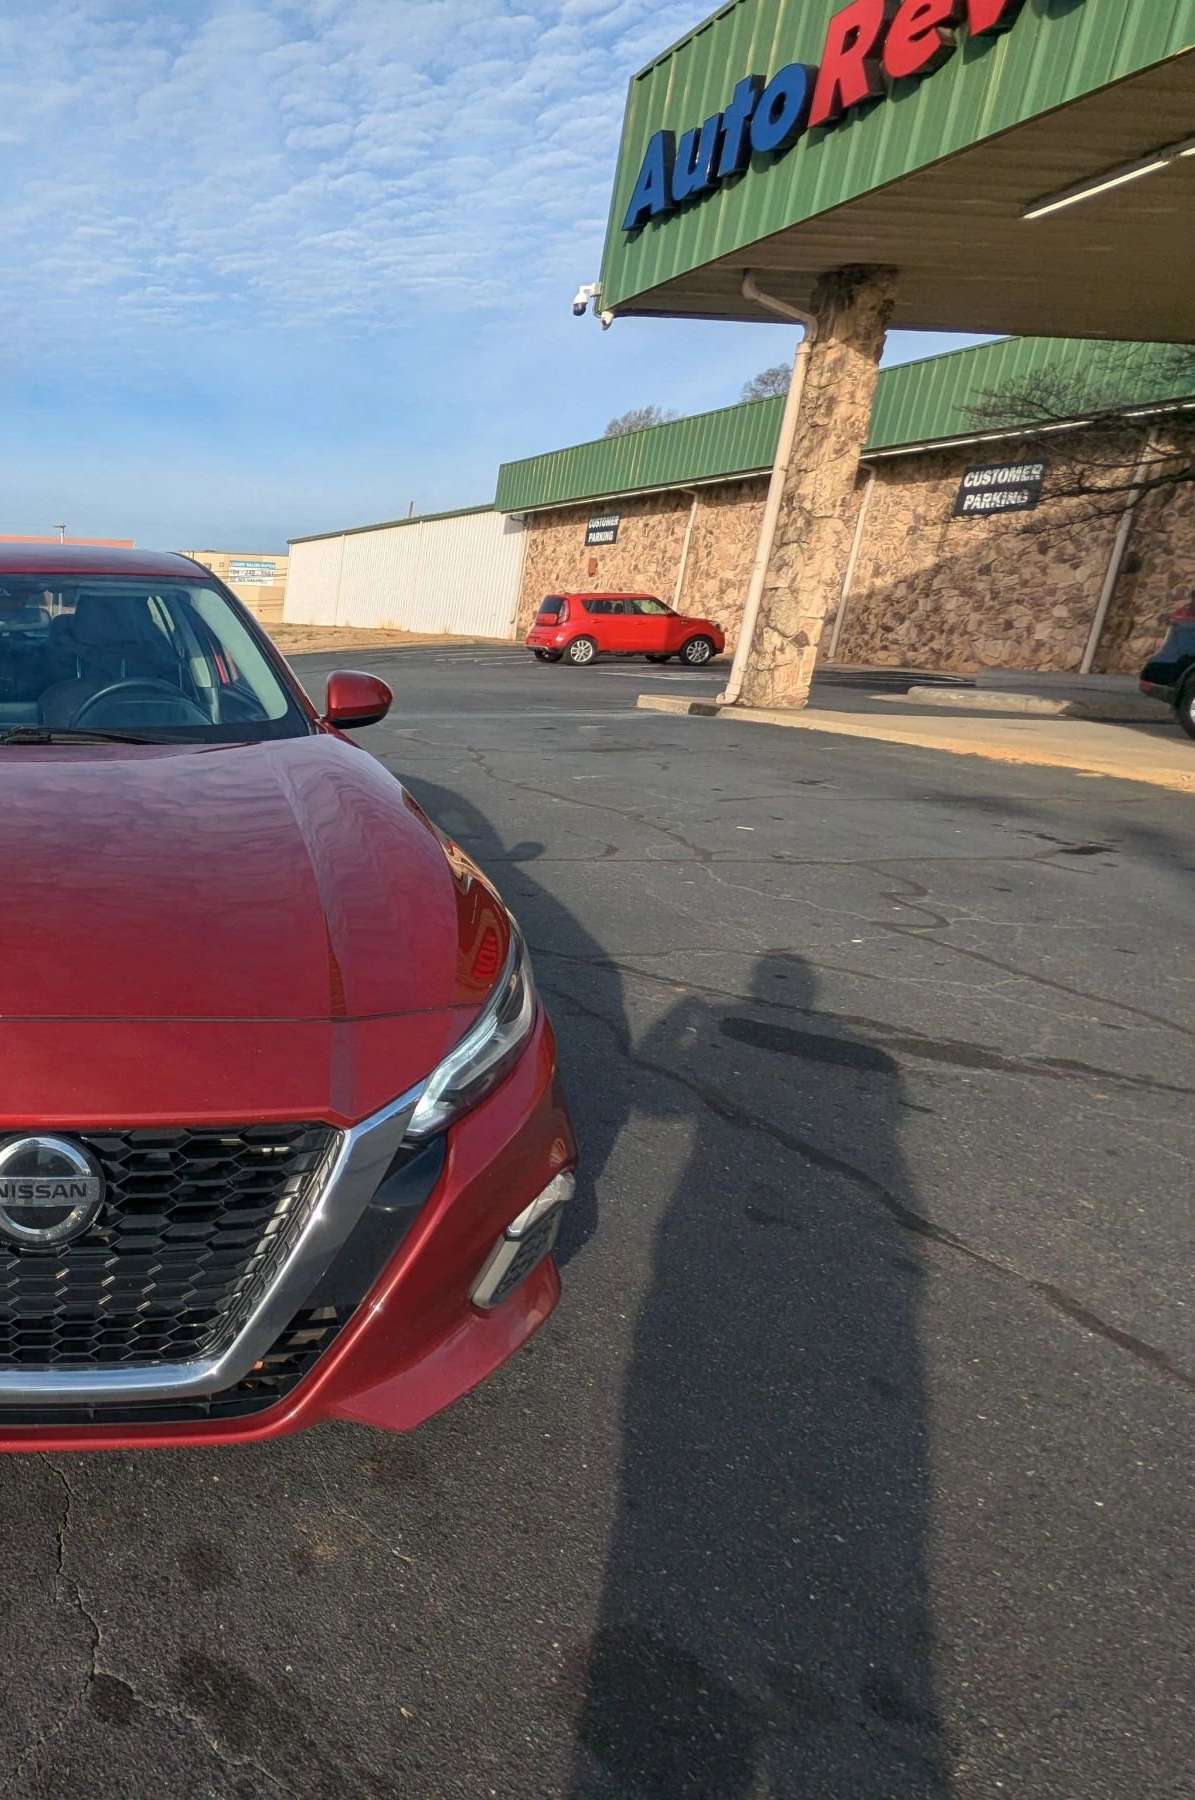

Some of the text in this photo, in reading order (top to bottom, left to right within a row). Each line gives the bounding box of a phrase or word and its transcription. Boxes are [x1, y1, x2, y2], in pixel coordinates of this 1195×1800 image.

[964, 463, 1044, 488] CUSTOMER
[962, 489, 1029, 511] PARKING
[588, 515, 620, 529] CUSTOMER
